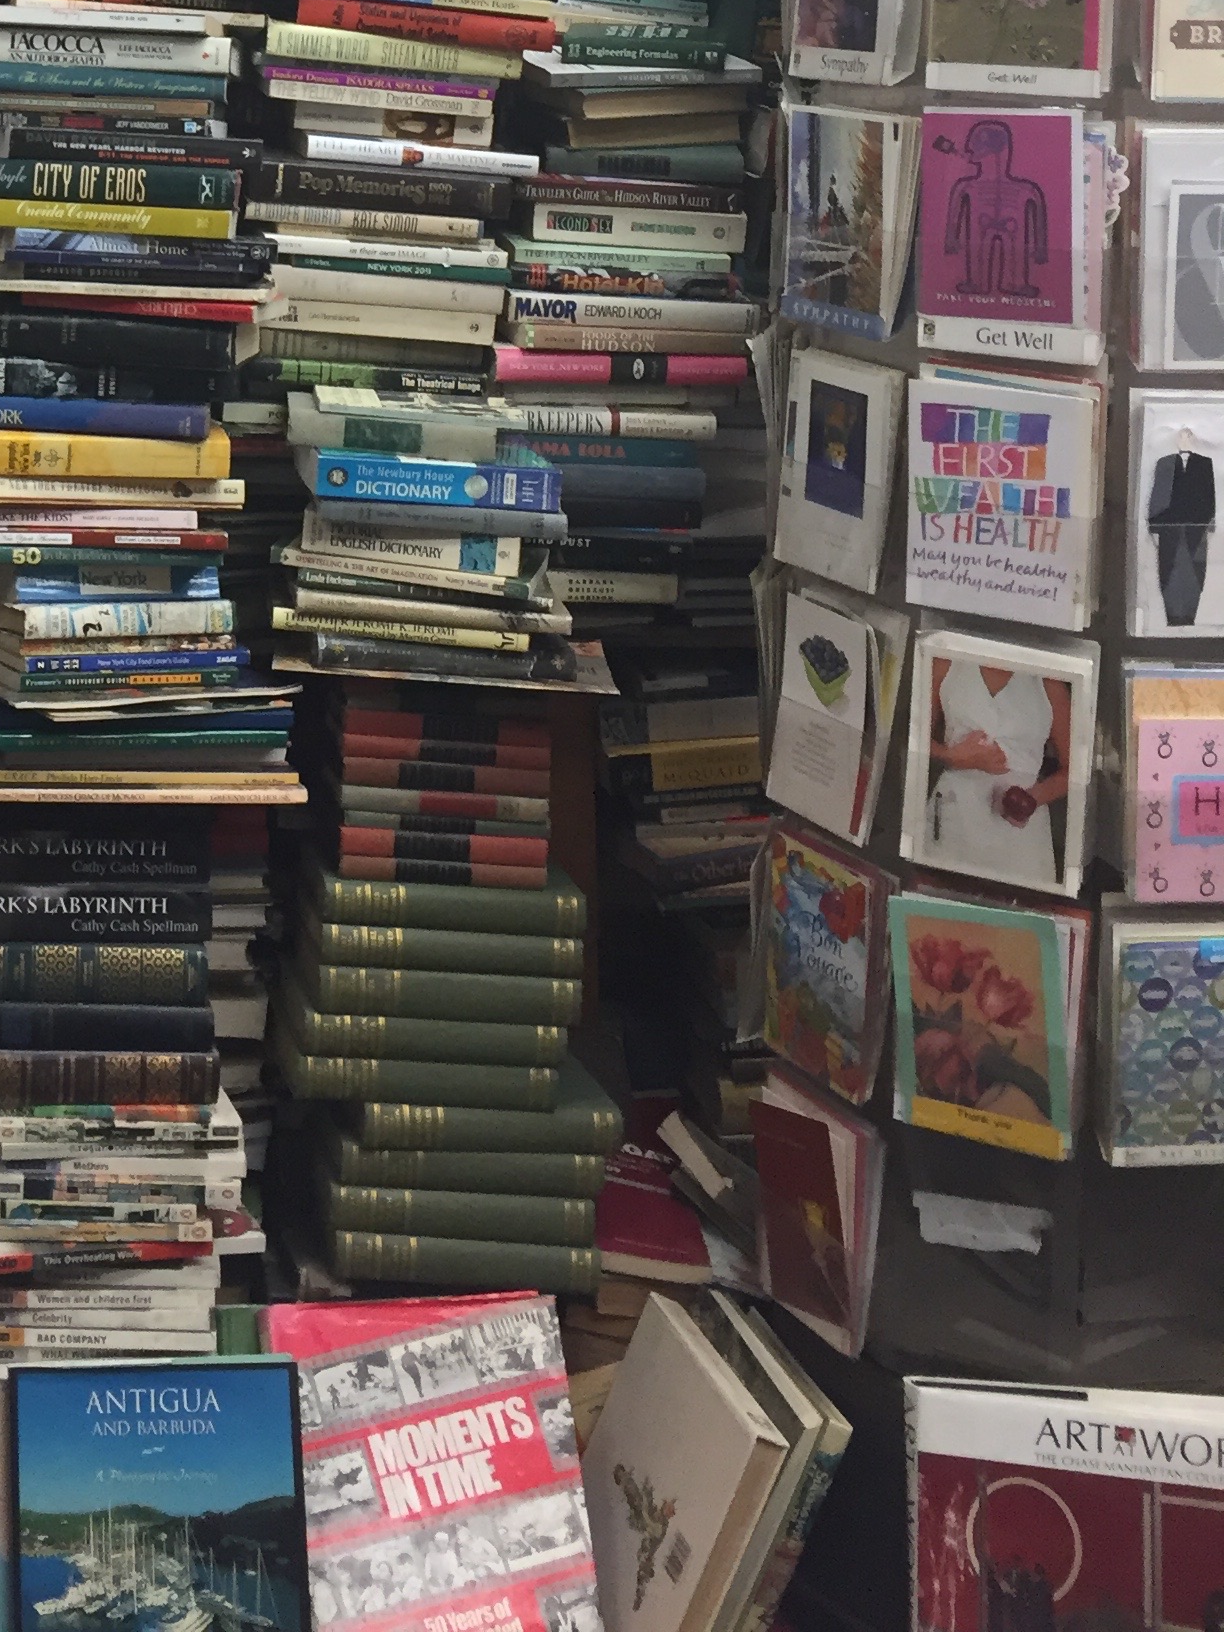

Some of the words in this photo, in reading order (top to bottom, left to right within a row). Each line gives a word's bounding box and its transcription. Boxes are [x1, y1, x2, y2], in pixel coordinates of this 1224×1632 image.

[9, 32, 105, 56] IACOCCA
[586, 45, 636, 60] Engineering
[639, 48, 679, 61] Formulas
[820, 54, 870, 75] Sympathy
[987, 72, 1005, 84] Get
[1009, 72, 1038, 84] Well
[33, 163, 73, 198] CITY
[79, 166, 100, 200] OF
[105, 168, 147, 202] EROS
[299, 171, 332, 195] Pop
[336, 174, 425, 204] Memories
[514, 297, 577, 321] MAYOR
[584, 305, 624, 320] EDWARD
[632, 307, 663, 322] KOCH
[792, 301, 872, 330] SYMPATHY
[976, 327, 1011, 347] Get
[1014, 330, 1055, 351] Well
[946, 408, 1020, 443] THE
[938, 443, 1039, 478] FIRST
[356, 480, 452, 501] DICTIONARY
[920, 514, 945, 543] IS
[952, 514, 1063, 555] HEALTH
[12, 547, 42, 565] 50
[330, 534, 376, 553] ENGLISH
[379, 539, 444, 560] DICTIONARY
[912, 547, 947, 565] May
[81, 571, 111, 585] New
[114, 571, 147, 588] York
[43, 896, 169, 916] LABYRINTH
[71, 919, 106, 936] Cathy
[109, 920, 140, 933] Cash
[142, 919, 199, 936] Spellman
[86, 1388, 221, 1416] ANTIGUA
[94, 1421, 131, 1437] AND
[137, 1421, 217, 1437] BARBUDA
[367, 1396, 535, 1477] MOMENTS
[1034, 1417, 1110, 1454] ART
[380, 1471, 422, 1519] IN
[417, 1448, 503, 1508] TIME
